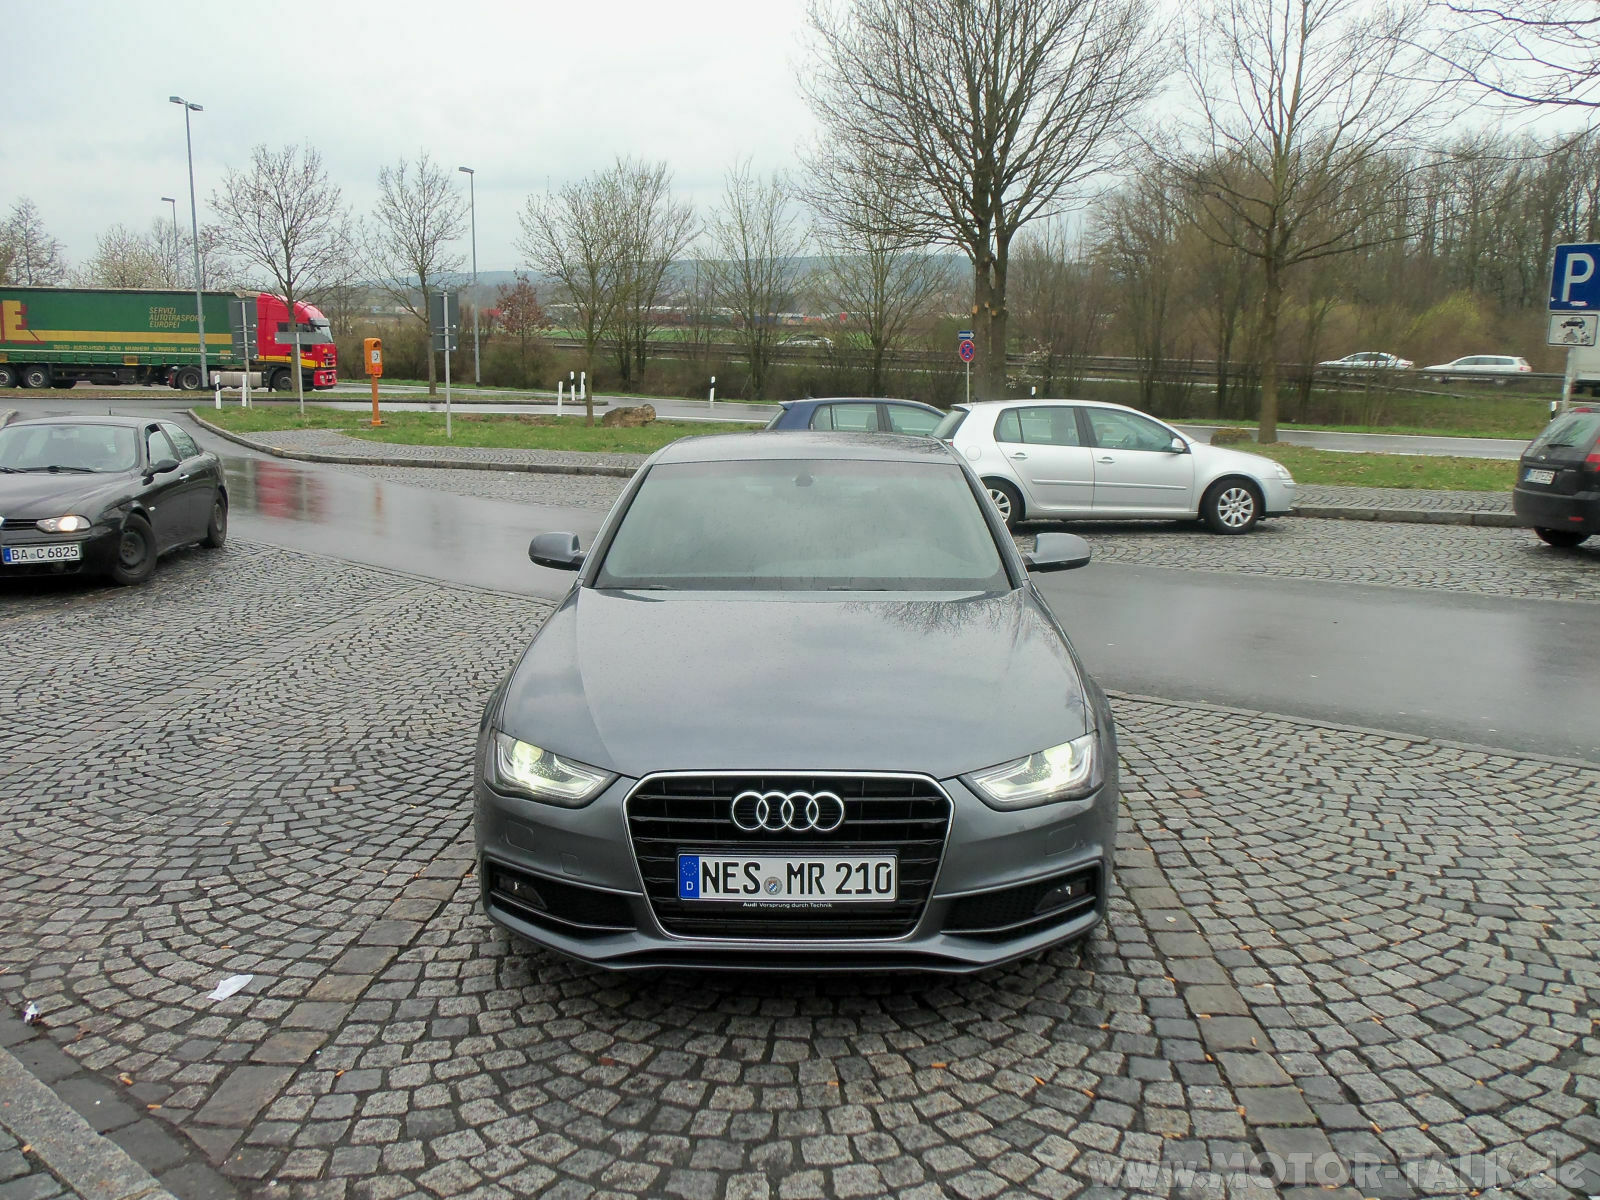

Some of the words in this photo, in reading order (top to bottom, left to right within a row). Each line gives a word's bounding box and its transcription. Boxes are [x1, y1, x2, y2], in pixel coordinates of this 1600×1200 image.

[1561, 252, 1595, 302] P
[149, 314, 206, 322] AUTOTRASPORI
[149, 321, 180, 329] EUROPEI
[11, 549, 28, 560] BA
[36, 548, 45, 559] C
[47, 546, 79, 558] 6825
[702, 861, 761, 894] NES
[786, 862, 826, 895] MR
[835, 862, 892, 895] 210
[685, 881, 694, 891] D
